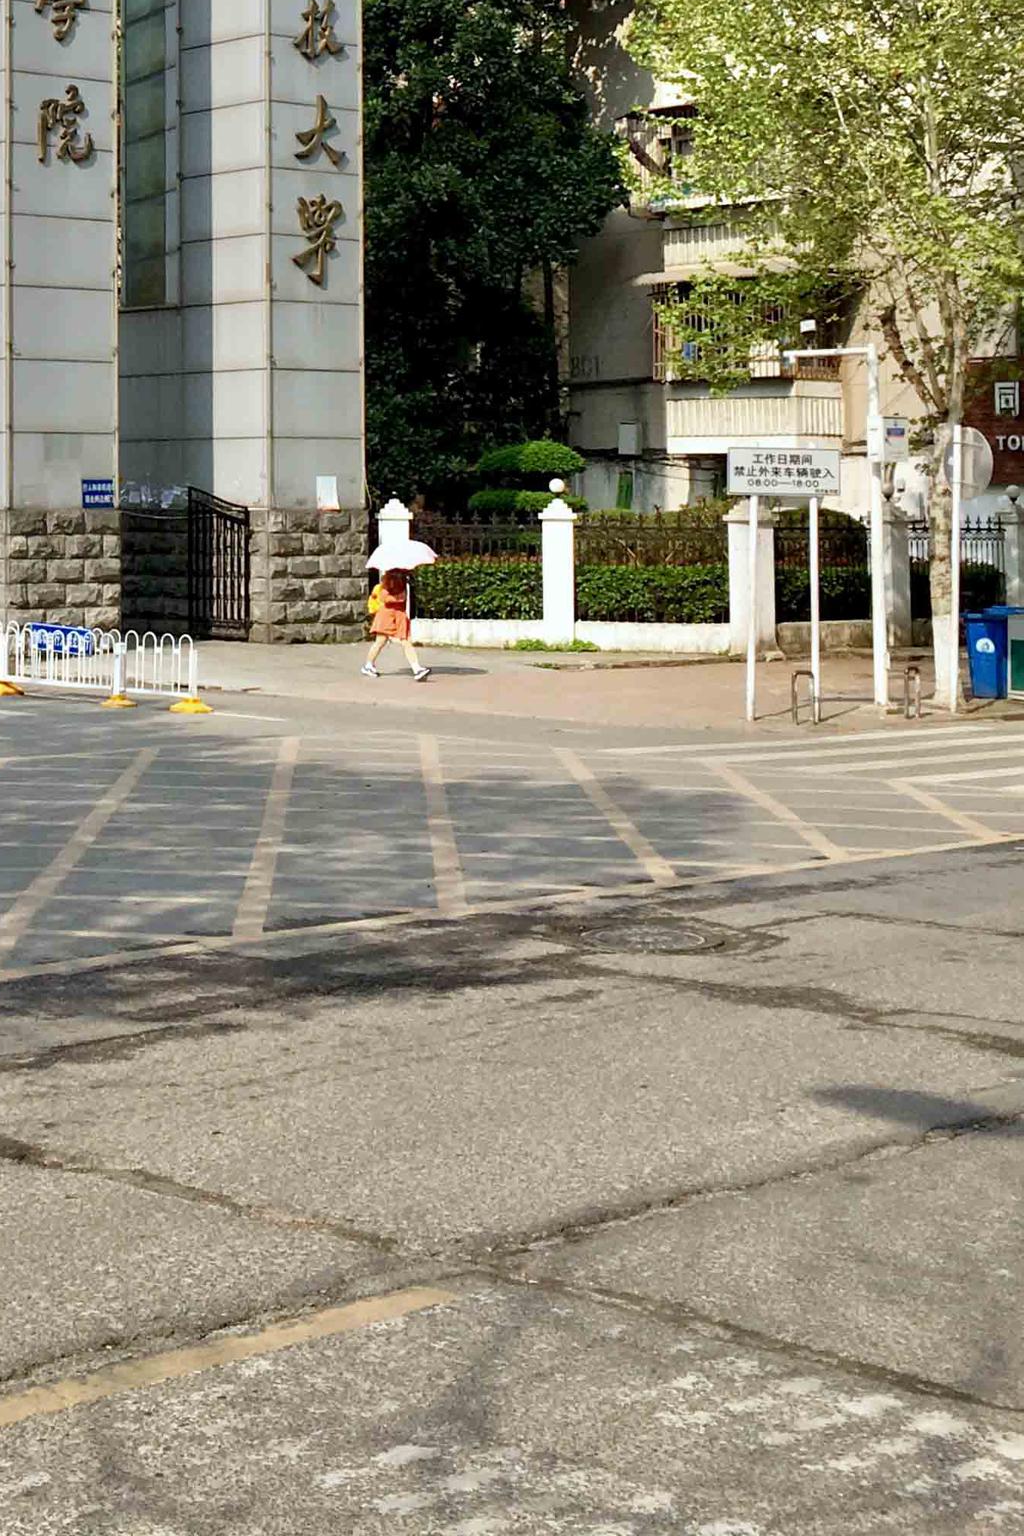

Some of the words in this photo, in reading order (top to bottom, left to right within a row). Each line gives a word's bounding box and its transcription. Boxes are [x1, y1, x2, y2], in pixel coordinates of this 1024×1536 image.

[994, 381, 1020, 417] 同
[995, 434, 1024, 451] TO
[752, 453, 813, 466] 工作日期间
[733, 465, 836, 479] 禁止外来车辆驶入
